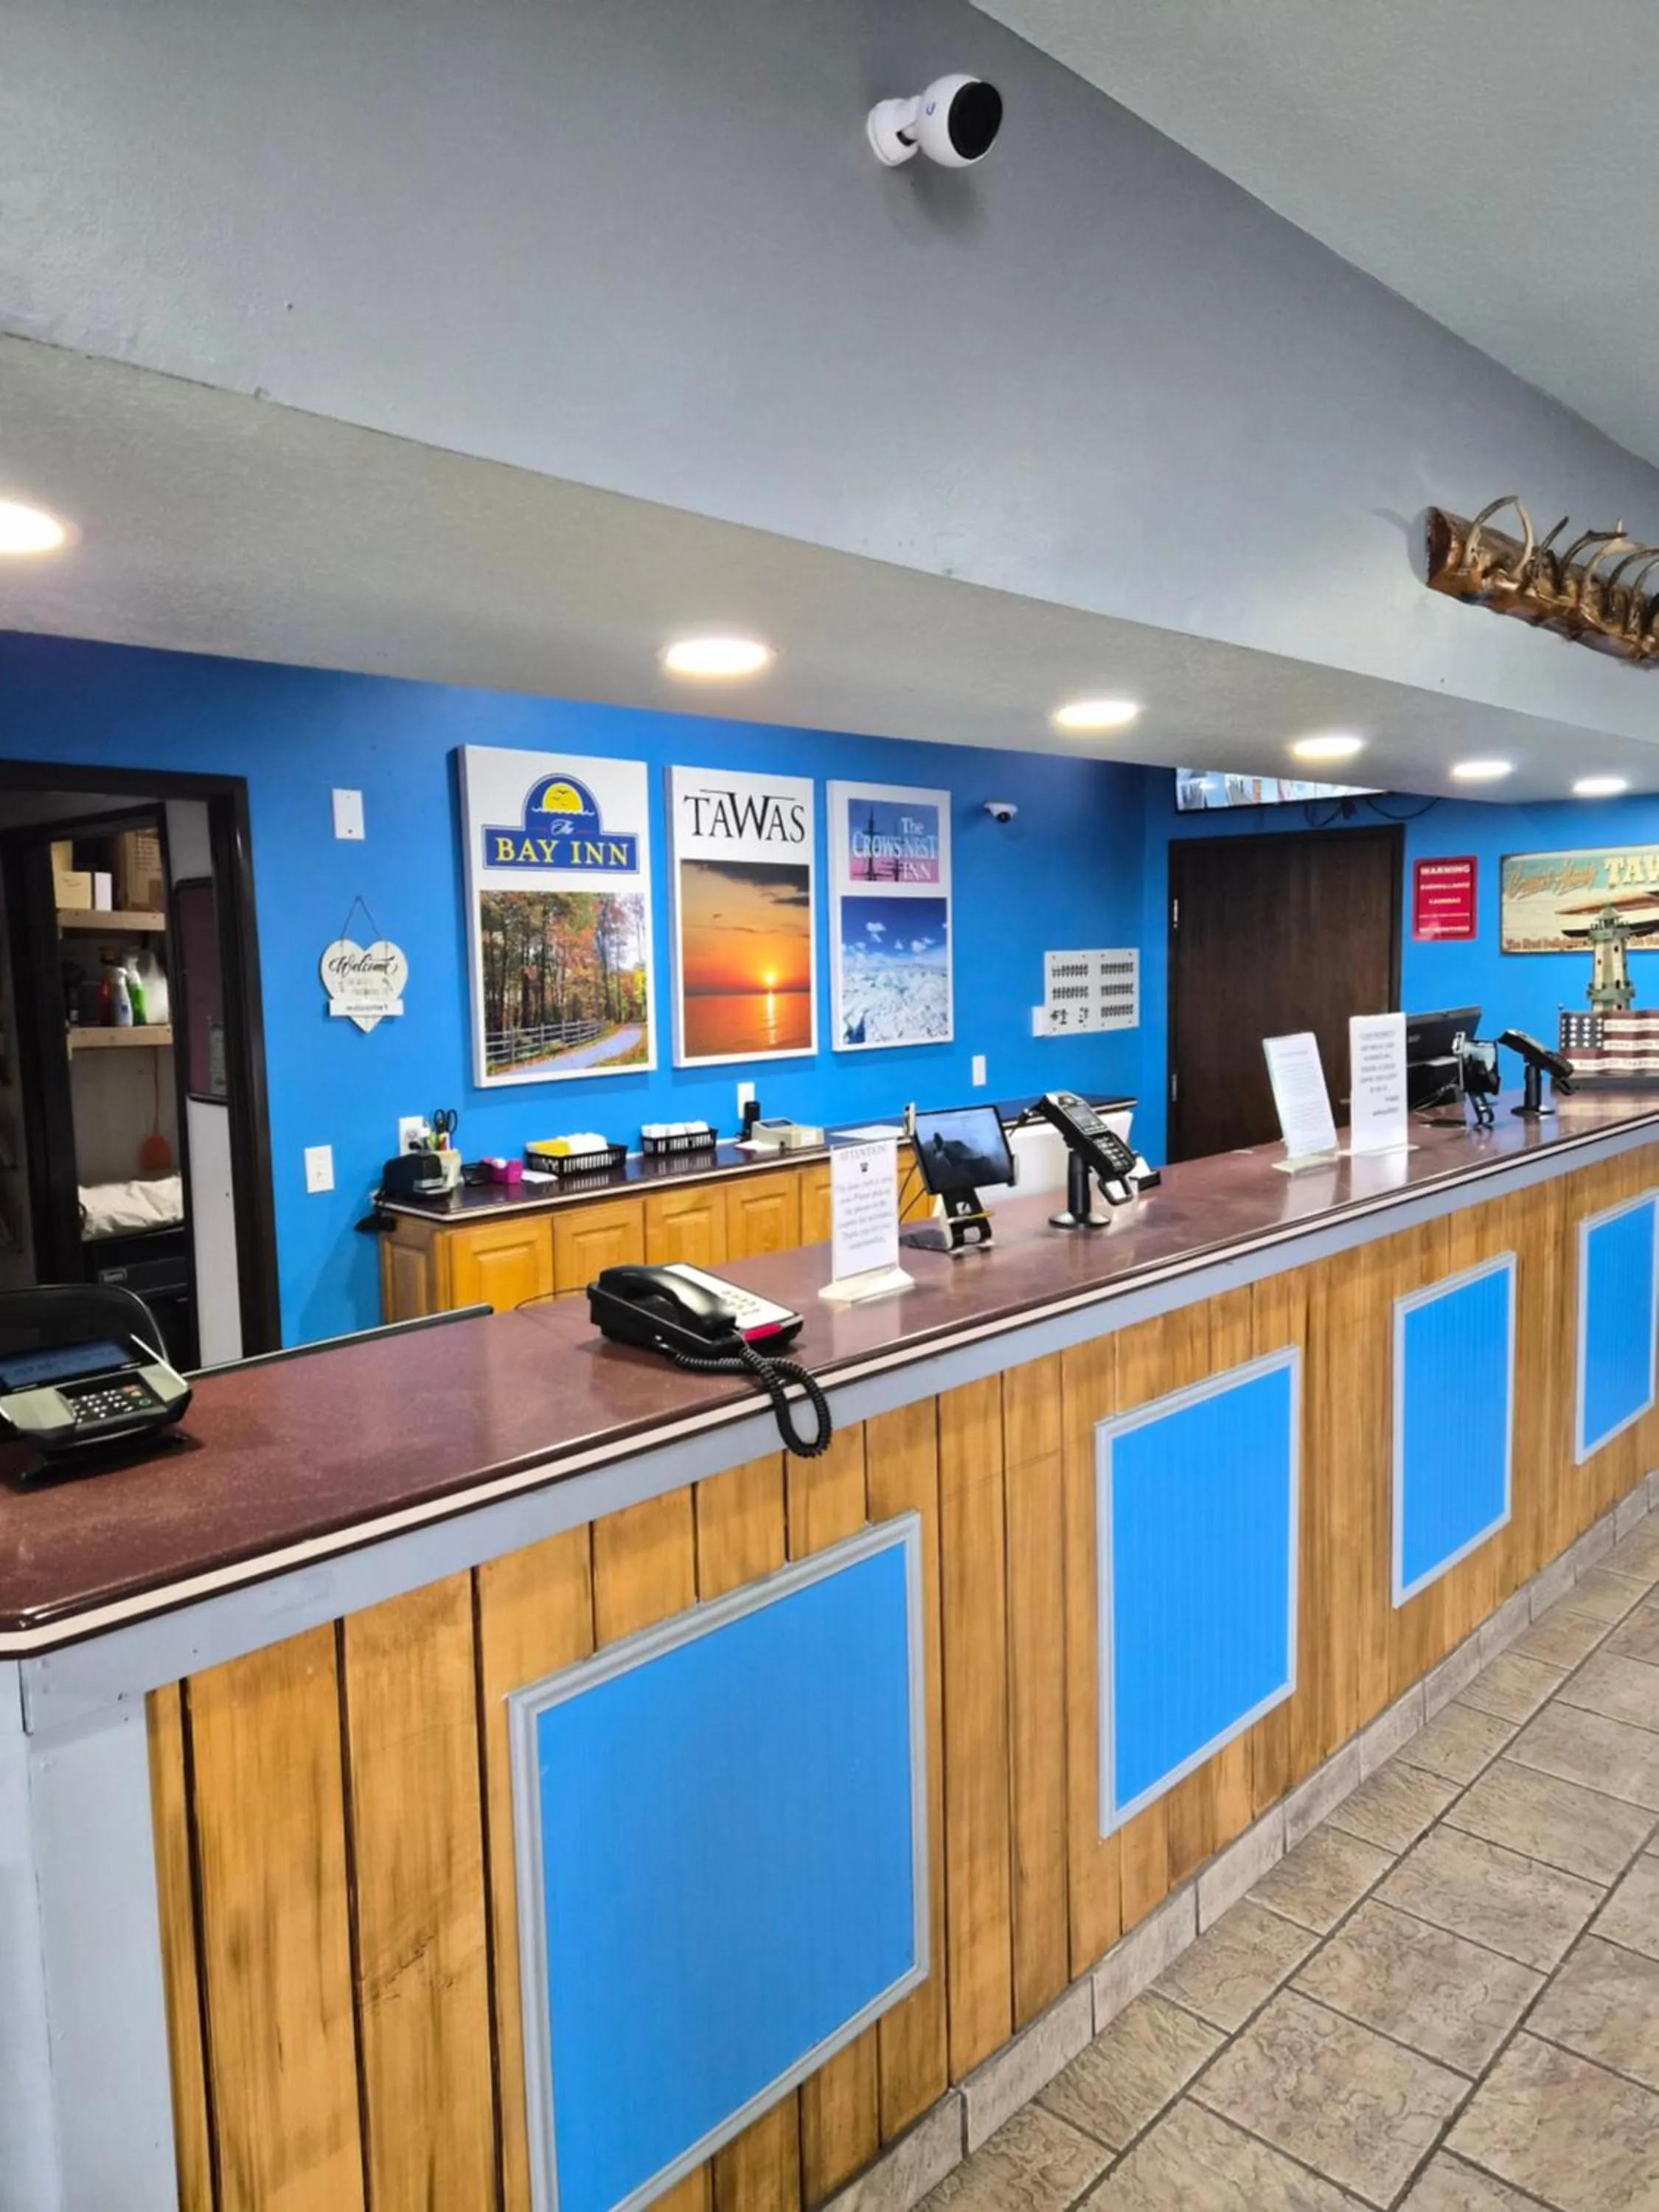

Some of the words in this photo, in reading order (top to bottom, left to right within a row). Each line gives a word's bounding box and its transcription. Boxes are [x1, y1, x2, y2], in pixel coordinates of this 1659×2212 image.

[684, 789, 805, 844] TAWAS
[900, 816, 924, 835] The
[495, 837, 559, 863] BAY
[570, 841, 629, 866] INN
